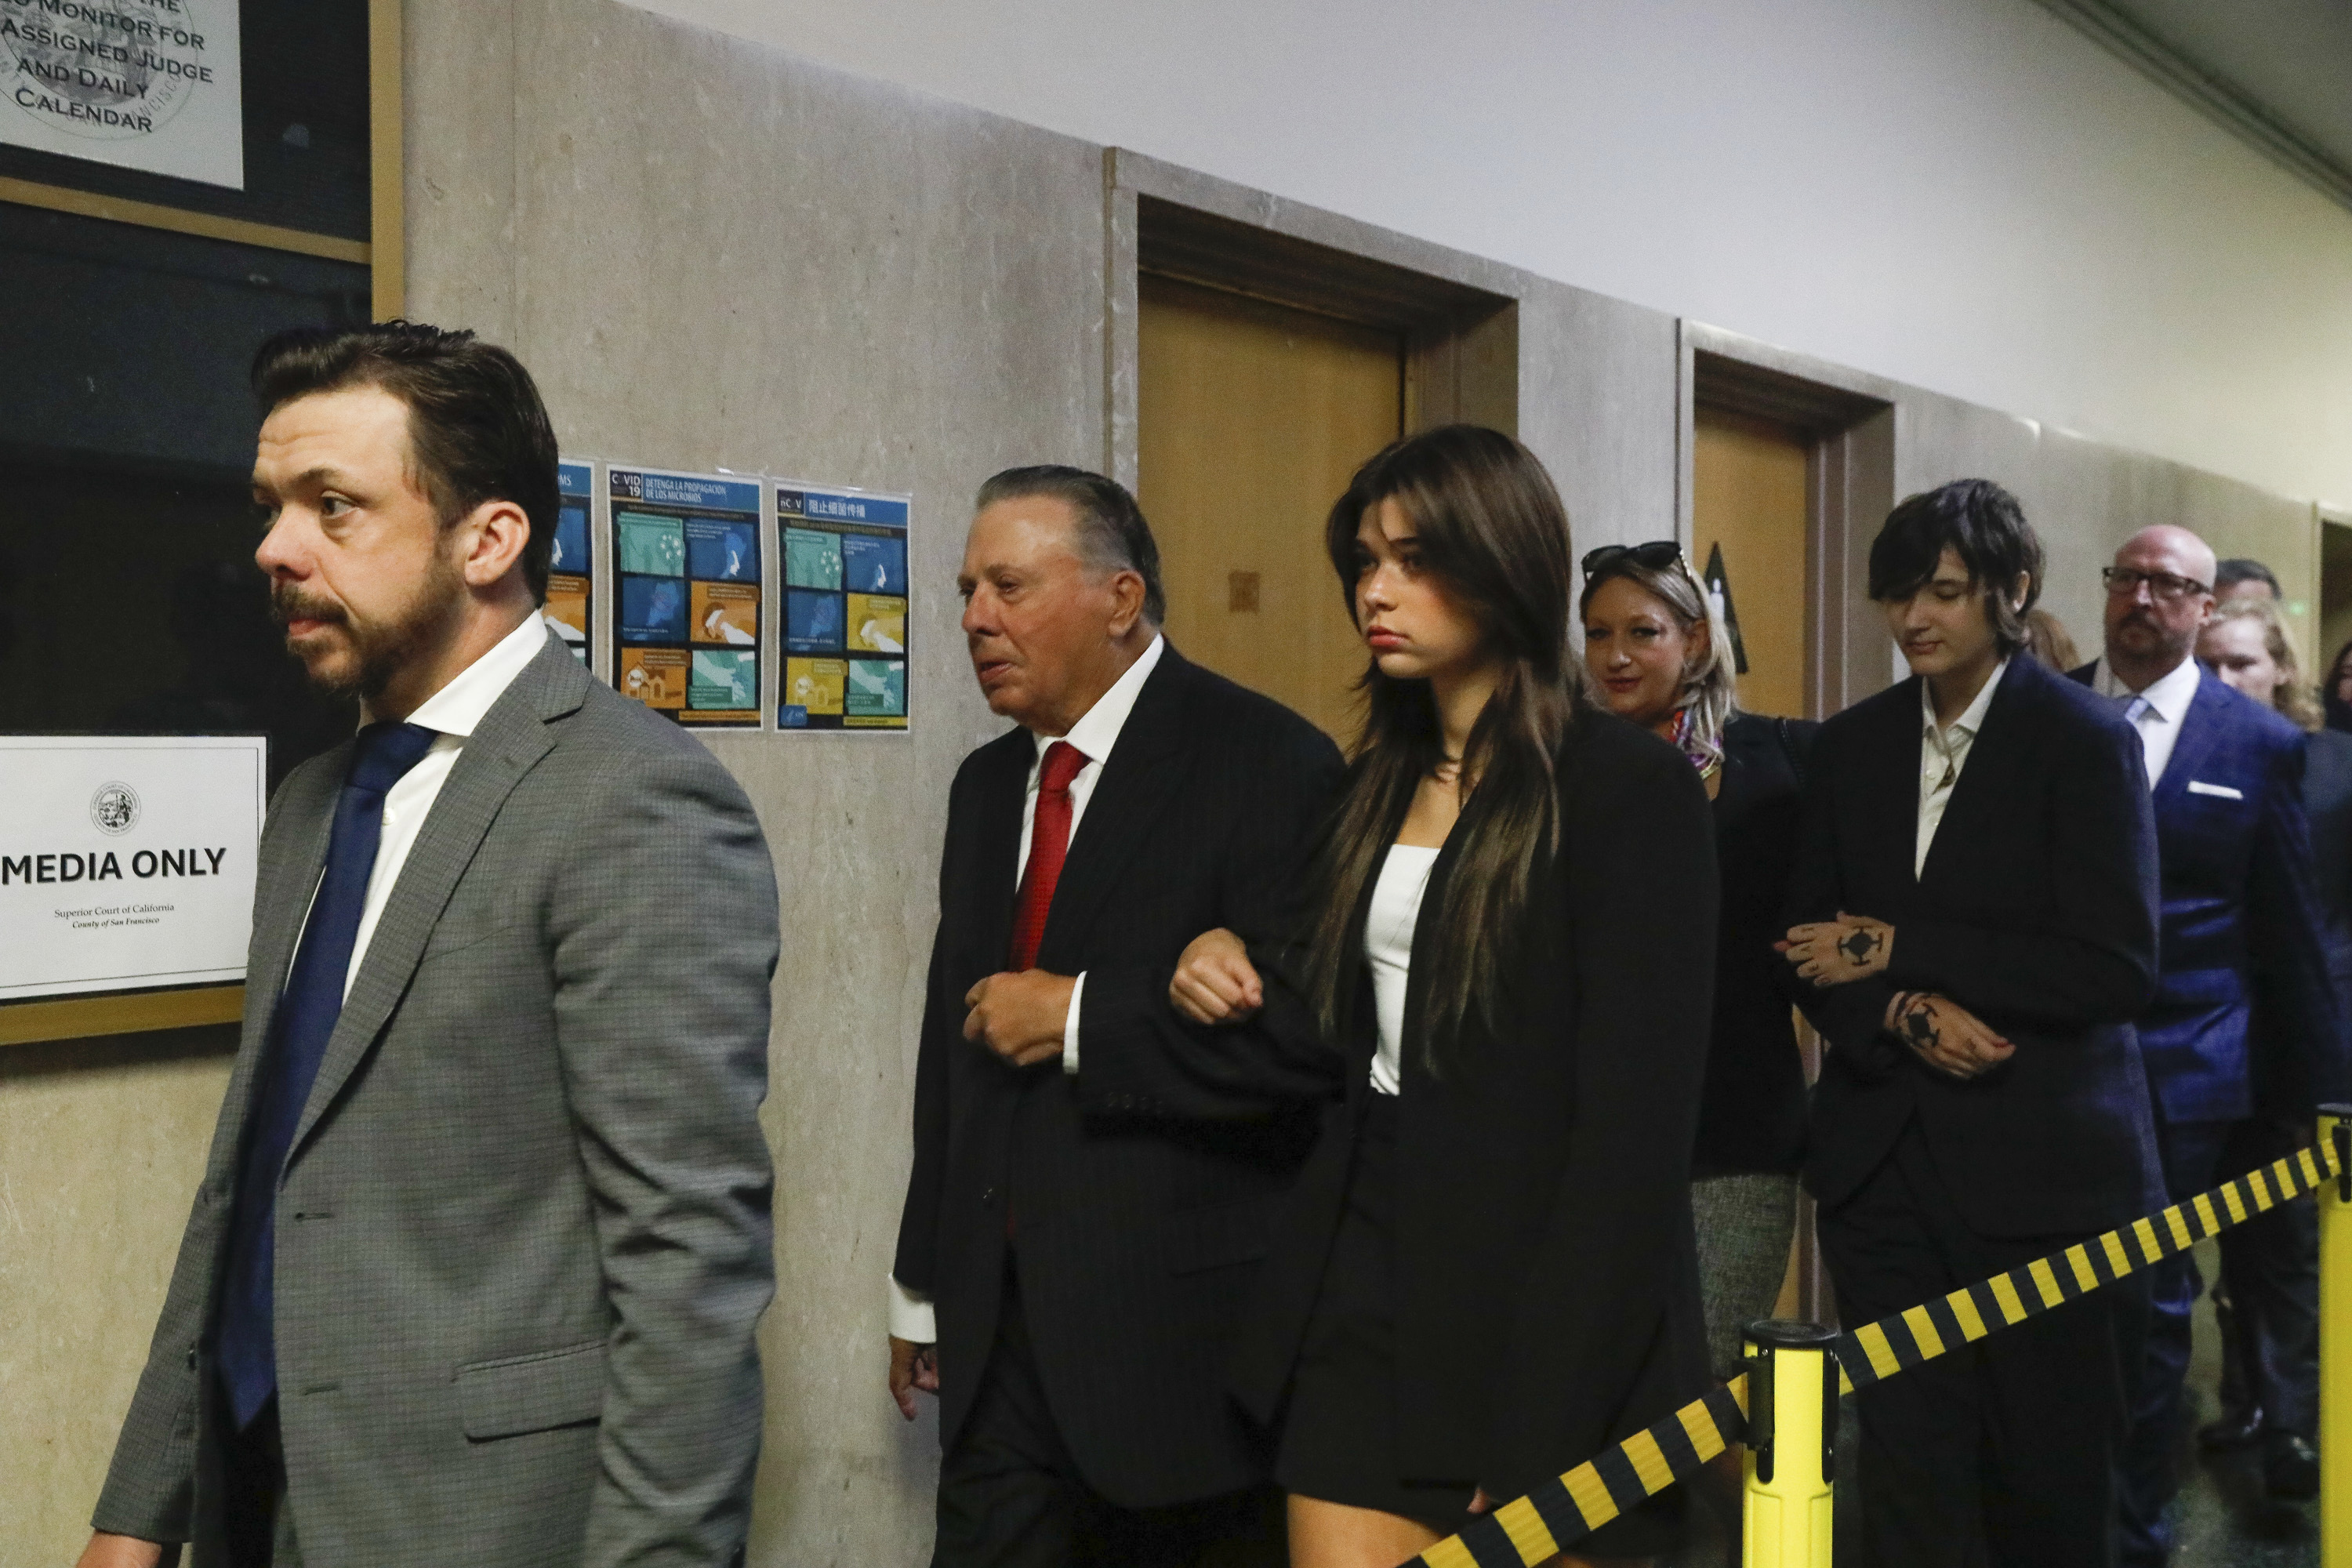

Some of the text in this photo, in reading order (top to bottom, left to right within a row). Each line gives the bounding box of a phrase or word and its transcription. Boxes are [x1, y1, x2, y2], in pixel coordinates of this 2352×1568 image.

[139, 0, 180, 13] HE
[38, 0, 205, 50] MONITOR FOR
[1, 19, 213, 84] ASSIGNED JUDGE
[17, 58, 149, 100] AND DAILY
[15, 85, 153, 132] CALENDAR
[629, 486, 641, 496] 19
[646, 477, 673, 490] DETENGA
[674, 481, 682, 492] LA
[646, 489, 702, 503] DE LOS MICROBIOS
[2, 848, 227, 884] MEDIA ONLY
[54, 902, 175, 920] Superior Court of California
[72, 920, 99, 929] County
[101, 919, 109, 928] of
[125, 916, 160, 925] Francisco
